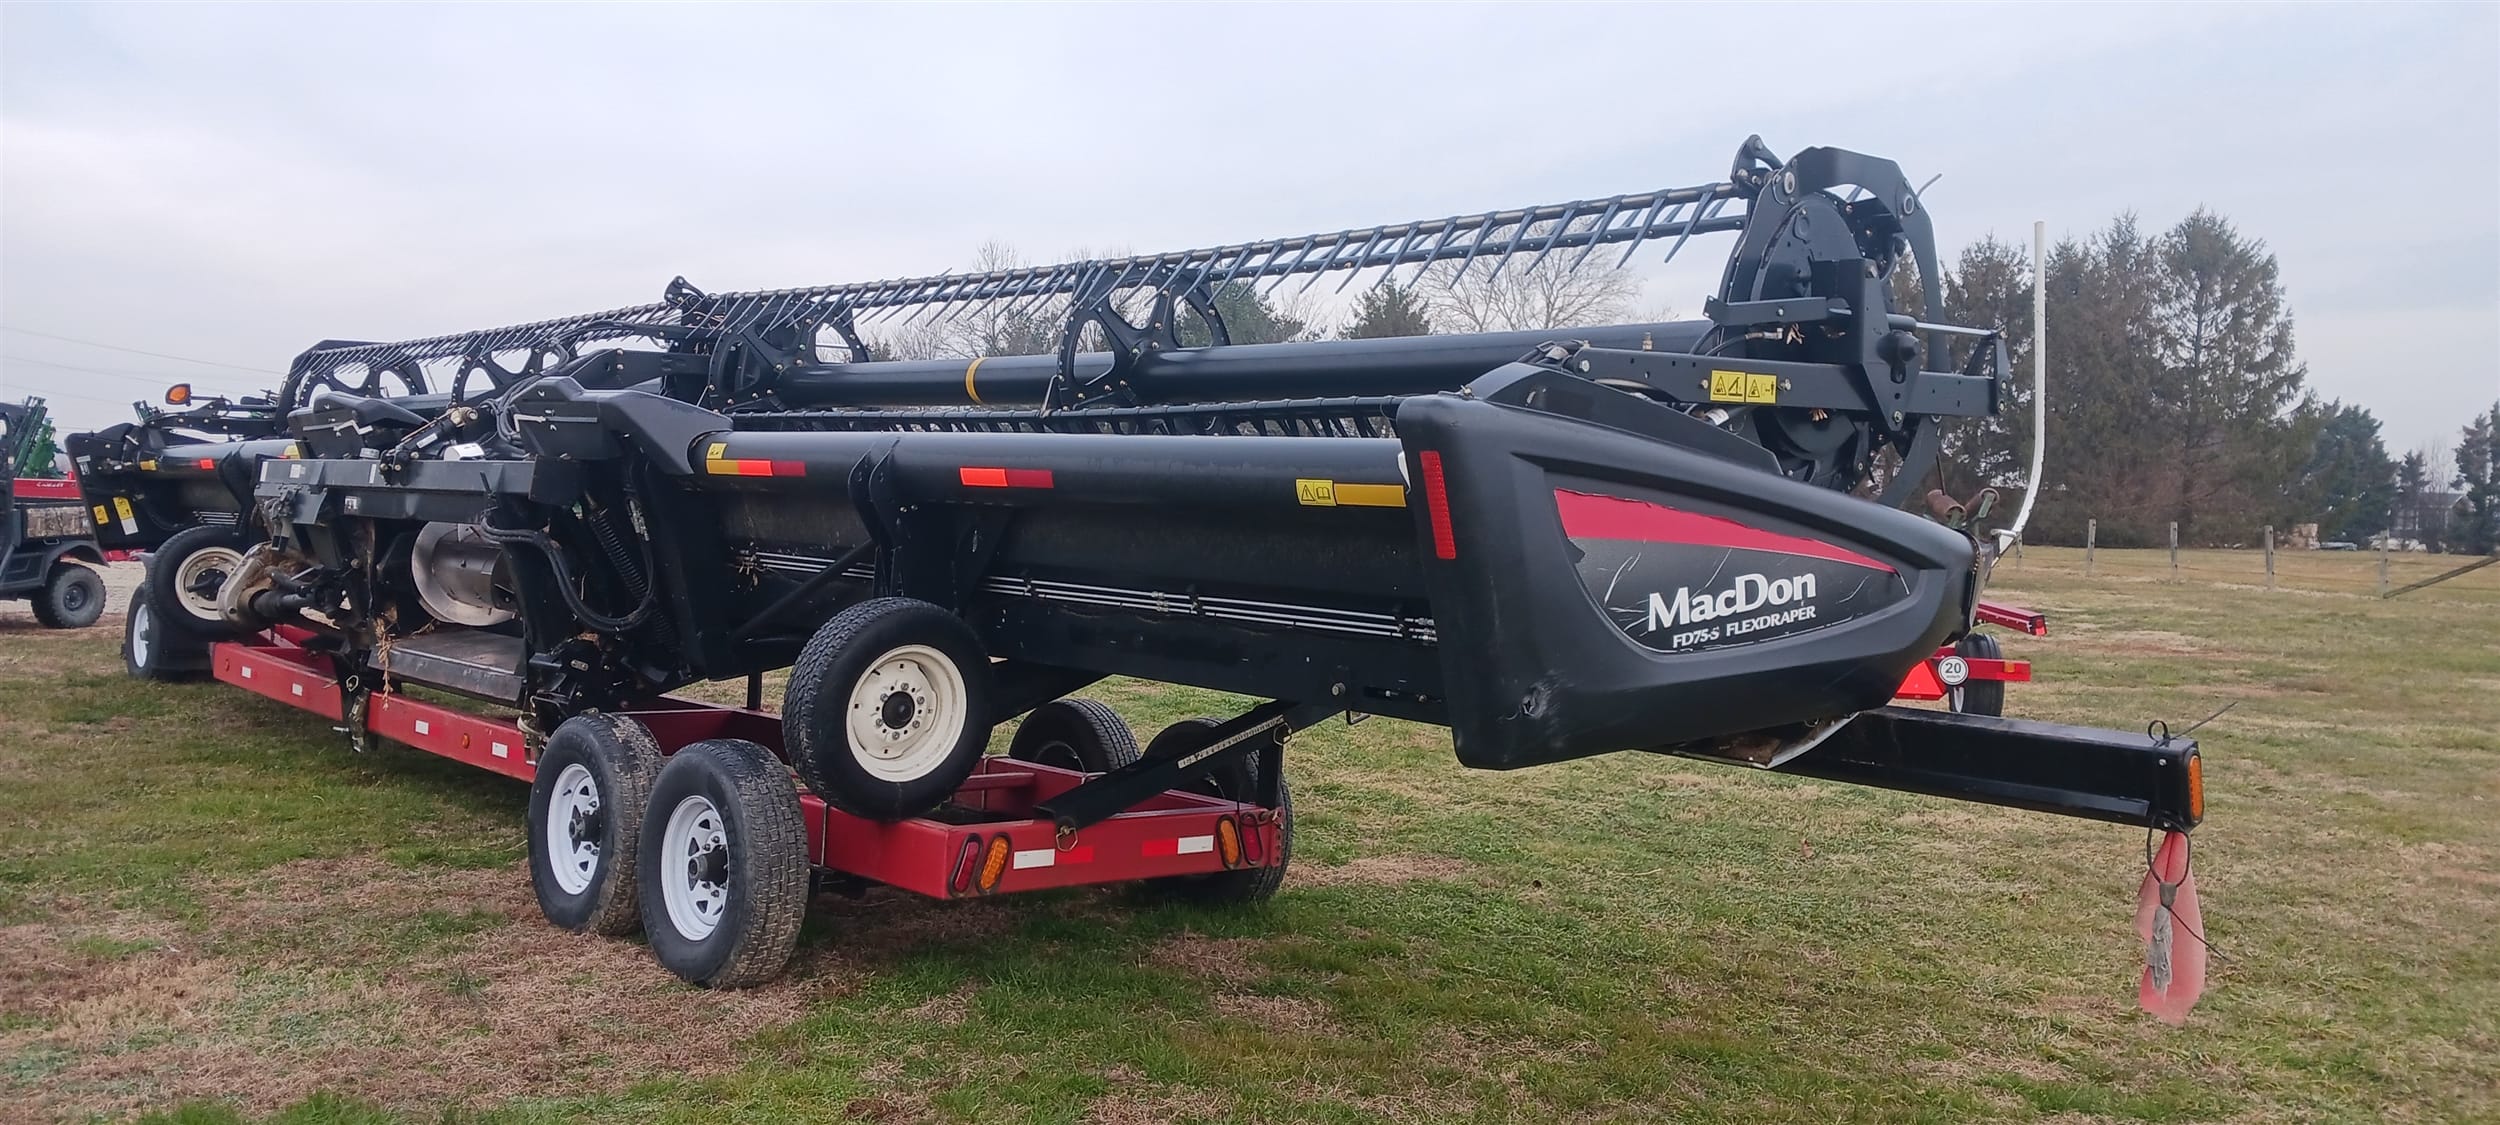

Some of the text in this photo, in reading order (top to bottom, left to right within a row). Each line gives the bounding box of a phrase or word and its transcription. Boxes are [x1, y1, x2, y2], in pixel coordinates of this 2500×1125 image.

[1648, 572, 1817, 632] MacDon
[1672, 605, 1817, 649] FD75-S FLEXDRAPER
[1944, 662, 1962, 674] 20
